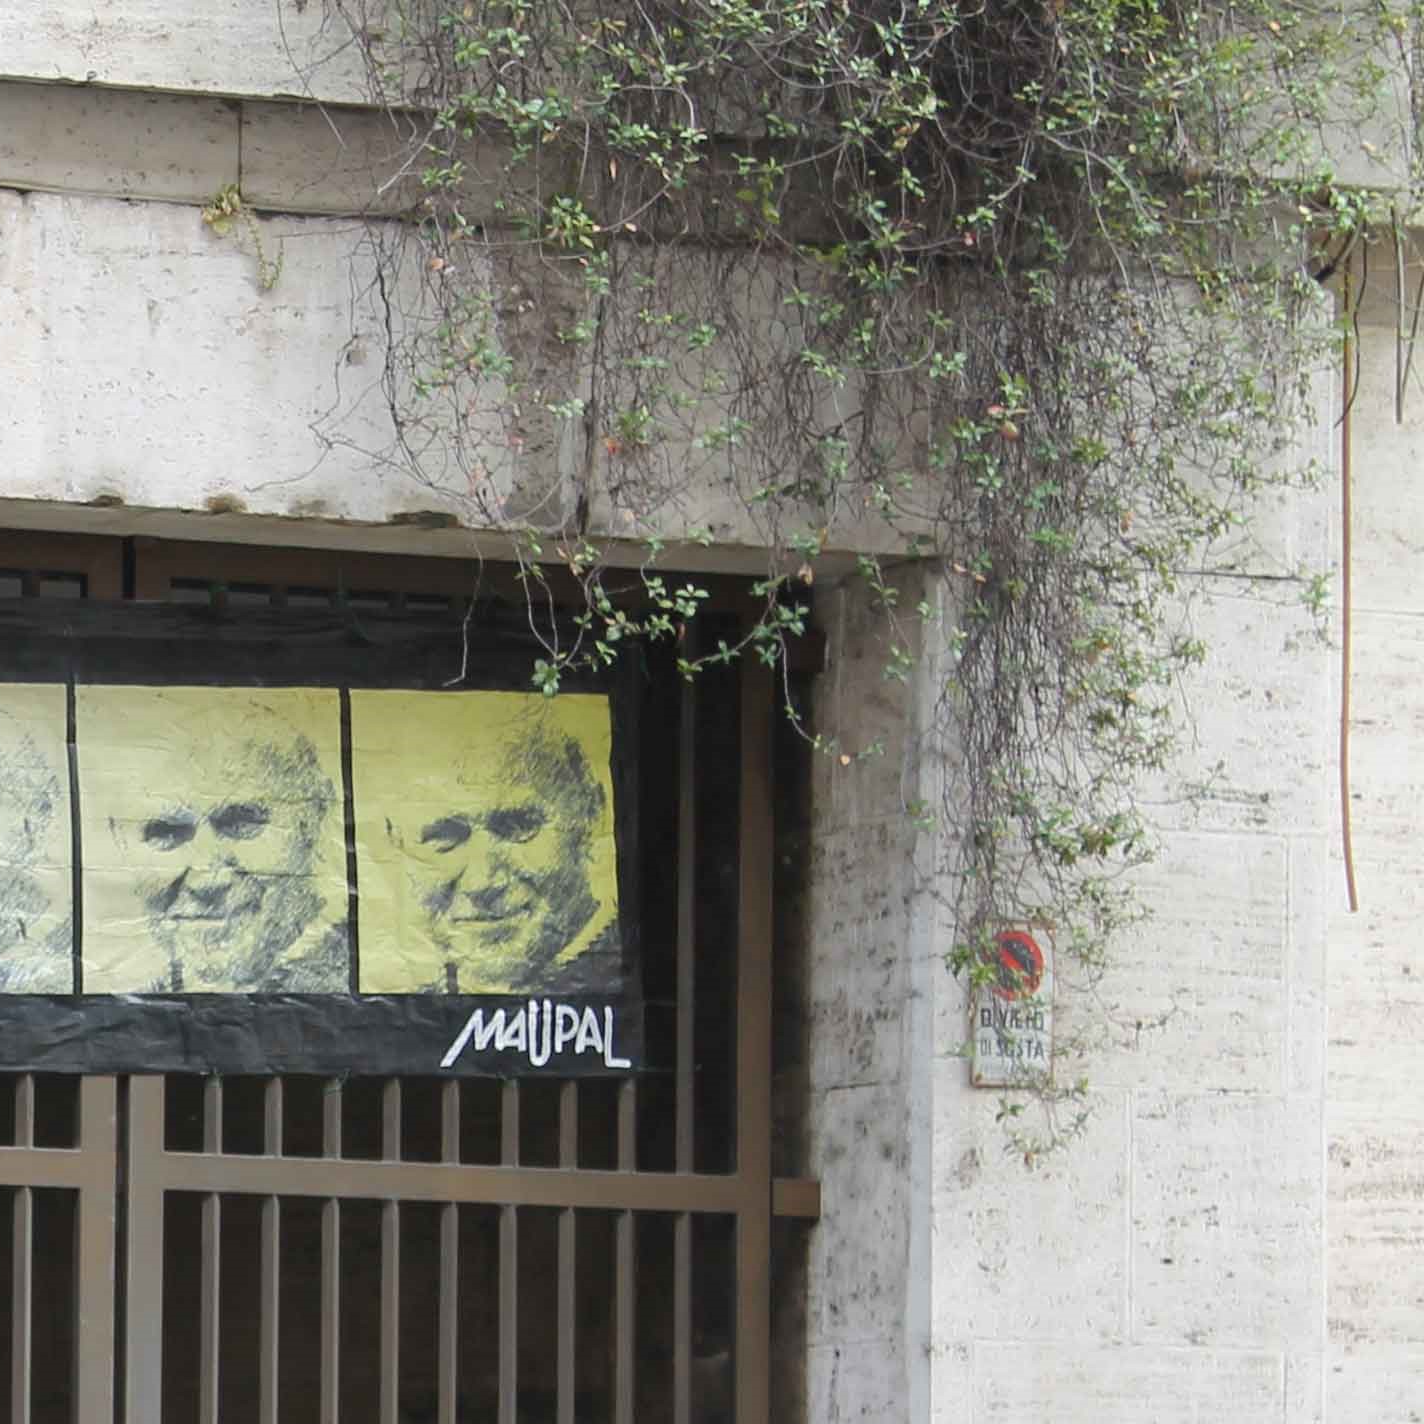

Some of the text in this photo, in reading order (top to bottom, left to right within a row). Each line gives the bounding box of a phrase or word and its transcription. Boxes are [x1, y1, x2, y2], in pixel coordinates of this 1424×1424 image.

[980, 1008, 1045, 1031] DVIETO
[439, 998, 632, 1068] MAUPAL
[980, 1039, 992, 1056] DI
